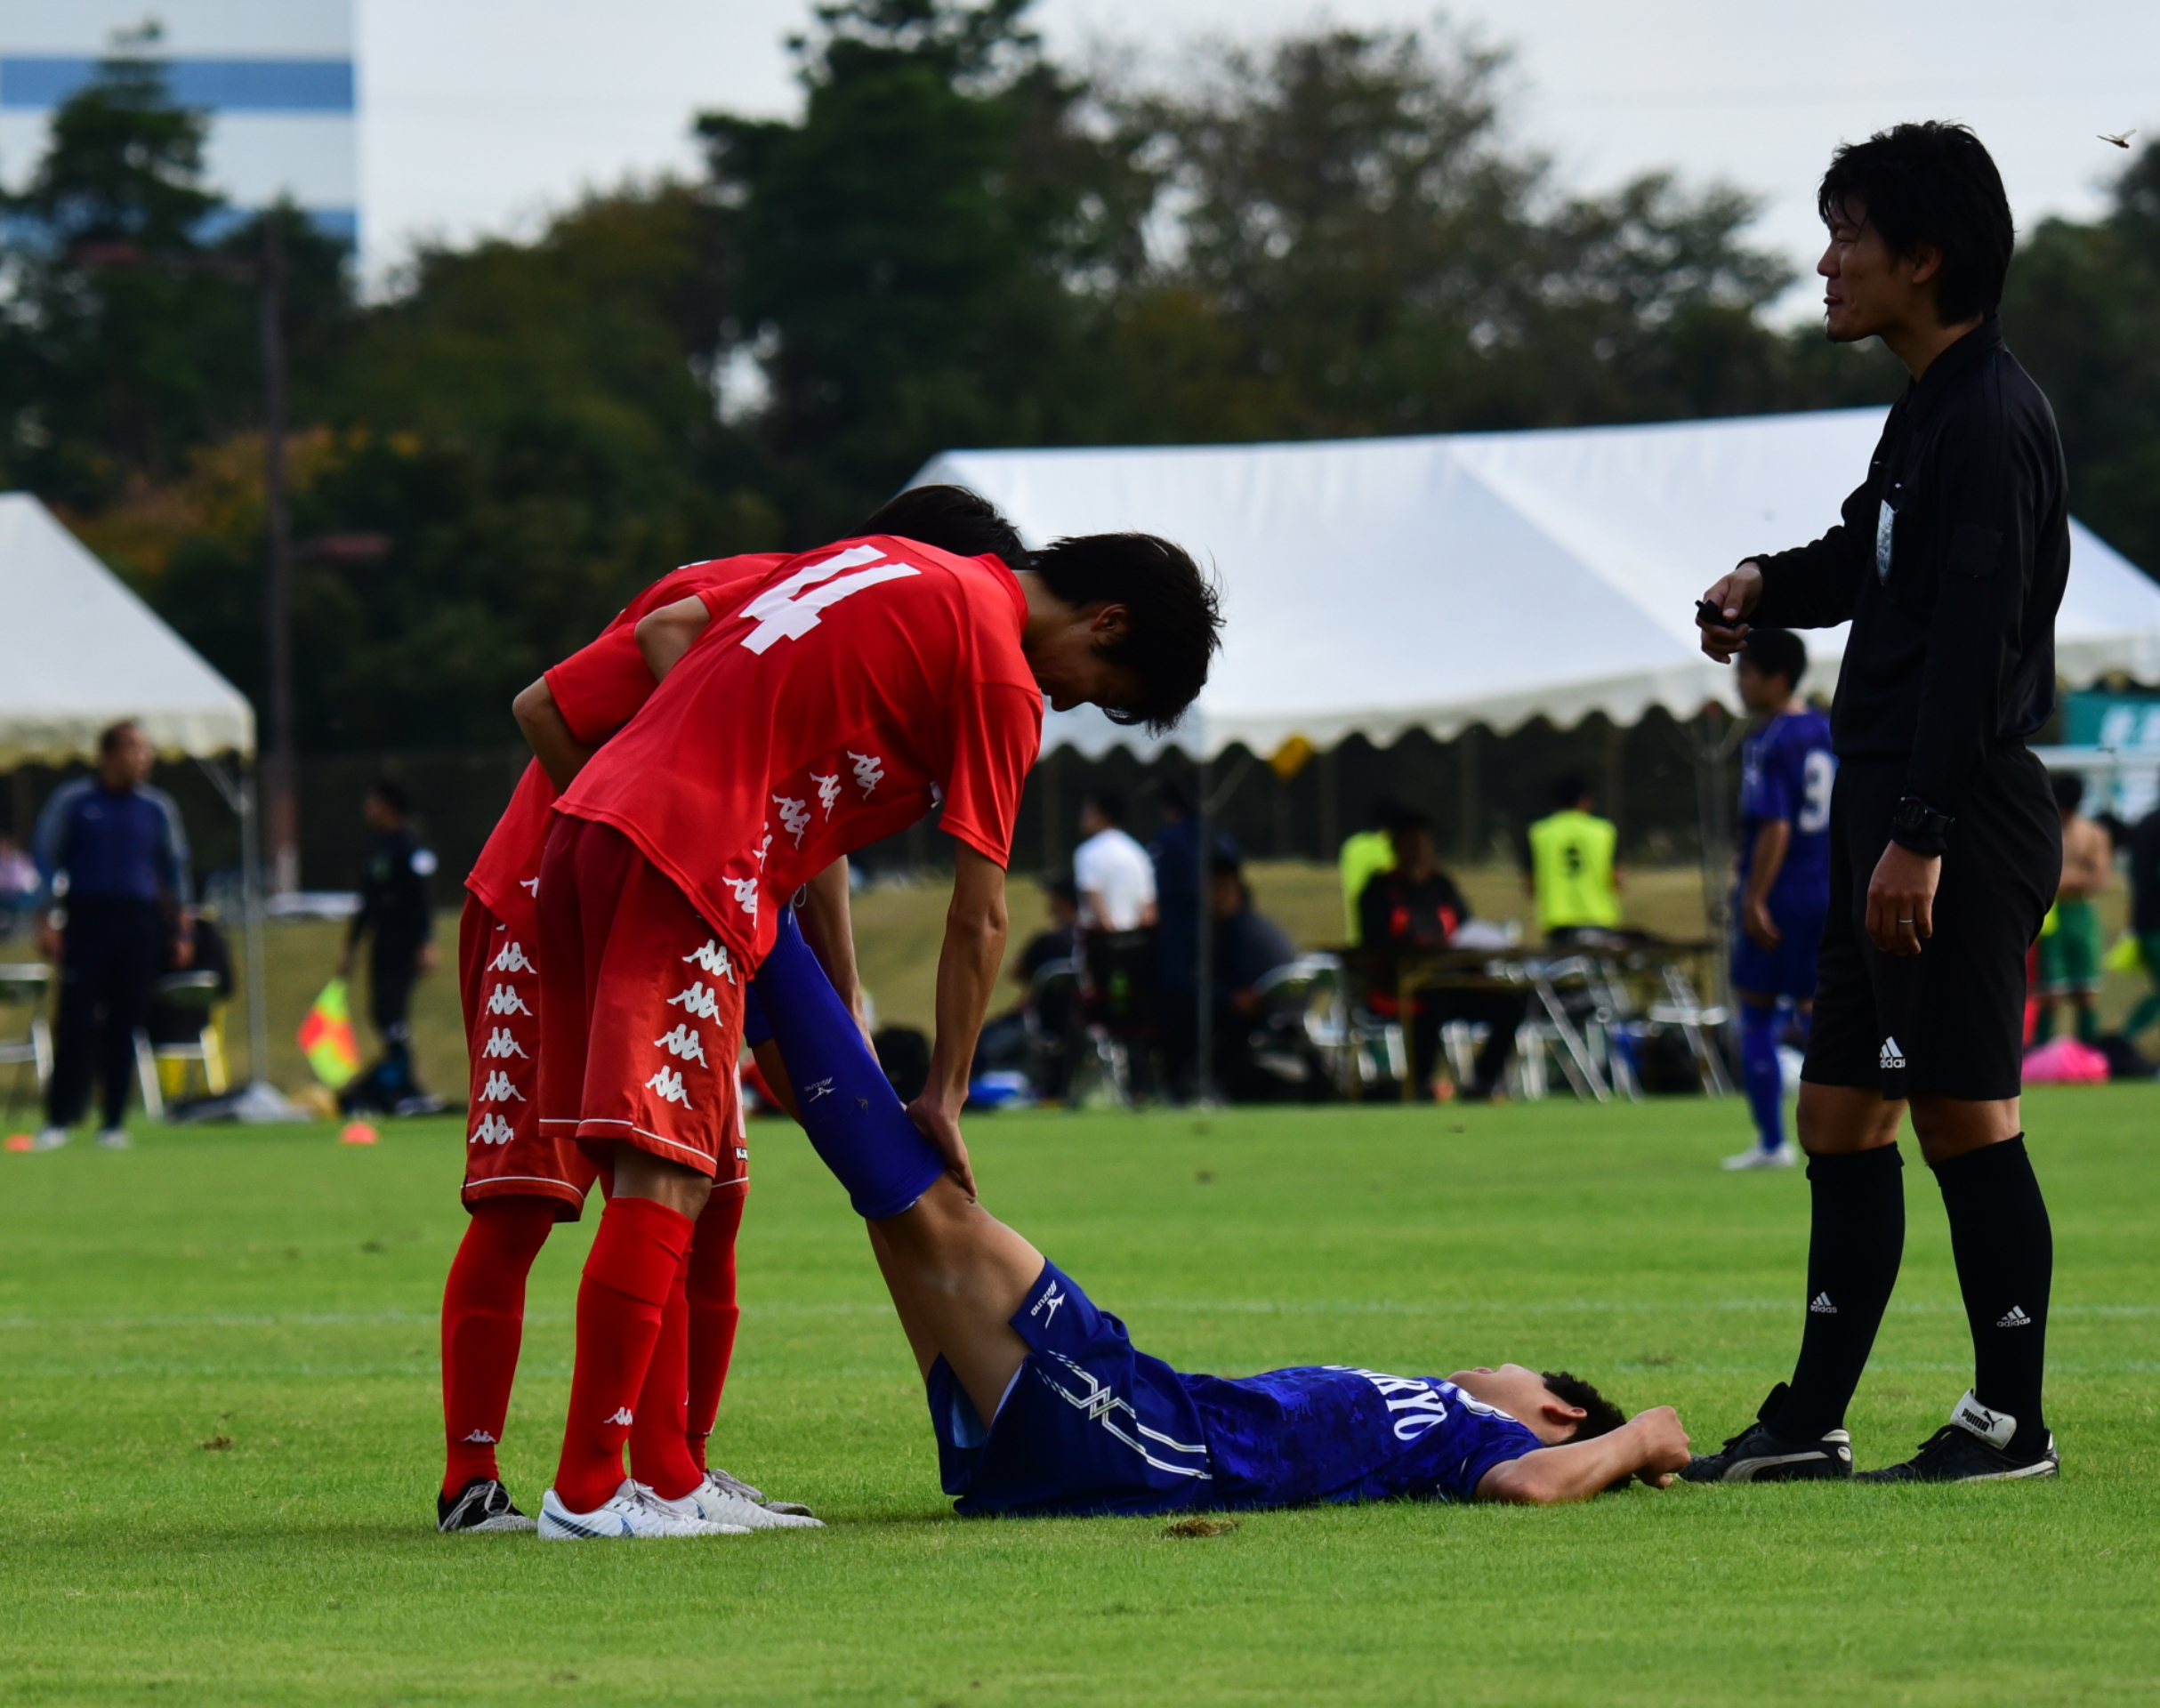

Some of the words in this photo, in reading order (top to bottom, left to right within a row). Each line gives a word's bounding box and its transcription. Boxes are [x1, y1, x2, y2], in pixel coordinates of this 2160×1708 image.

[737, 544, 923, 657] 4
[1996, 1317, 2031, 1328] adidas
[1961, 1407, 1990, 1433] PUMA
